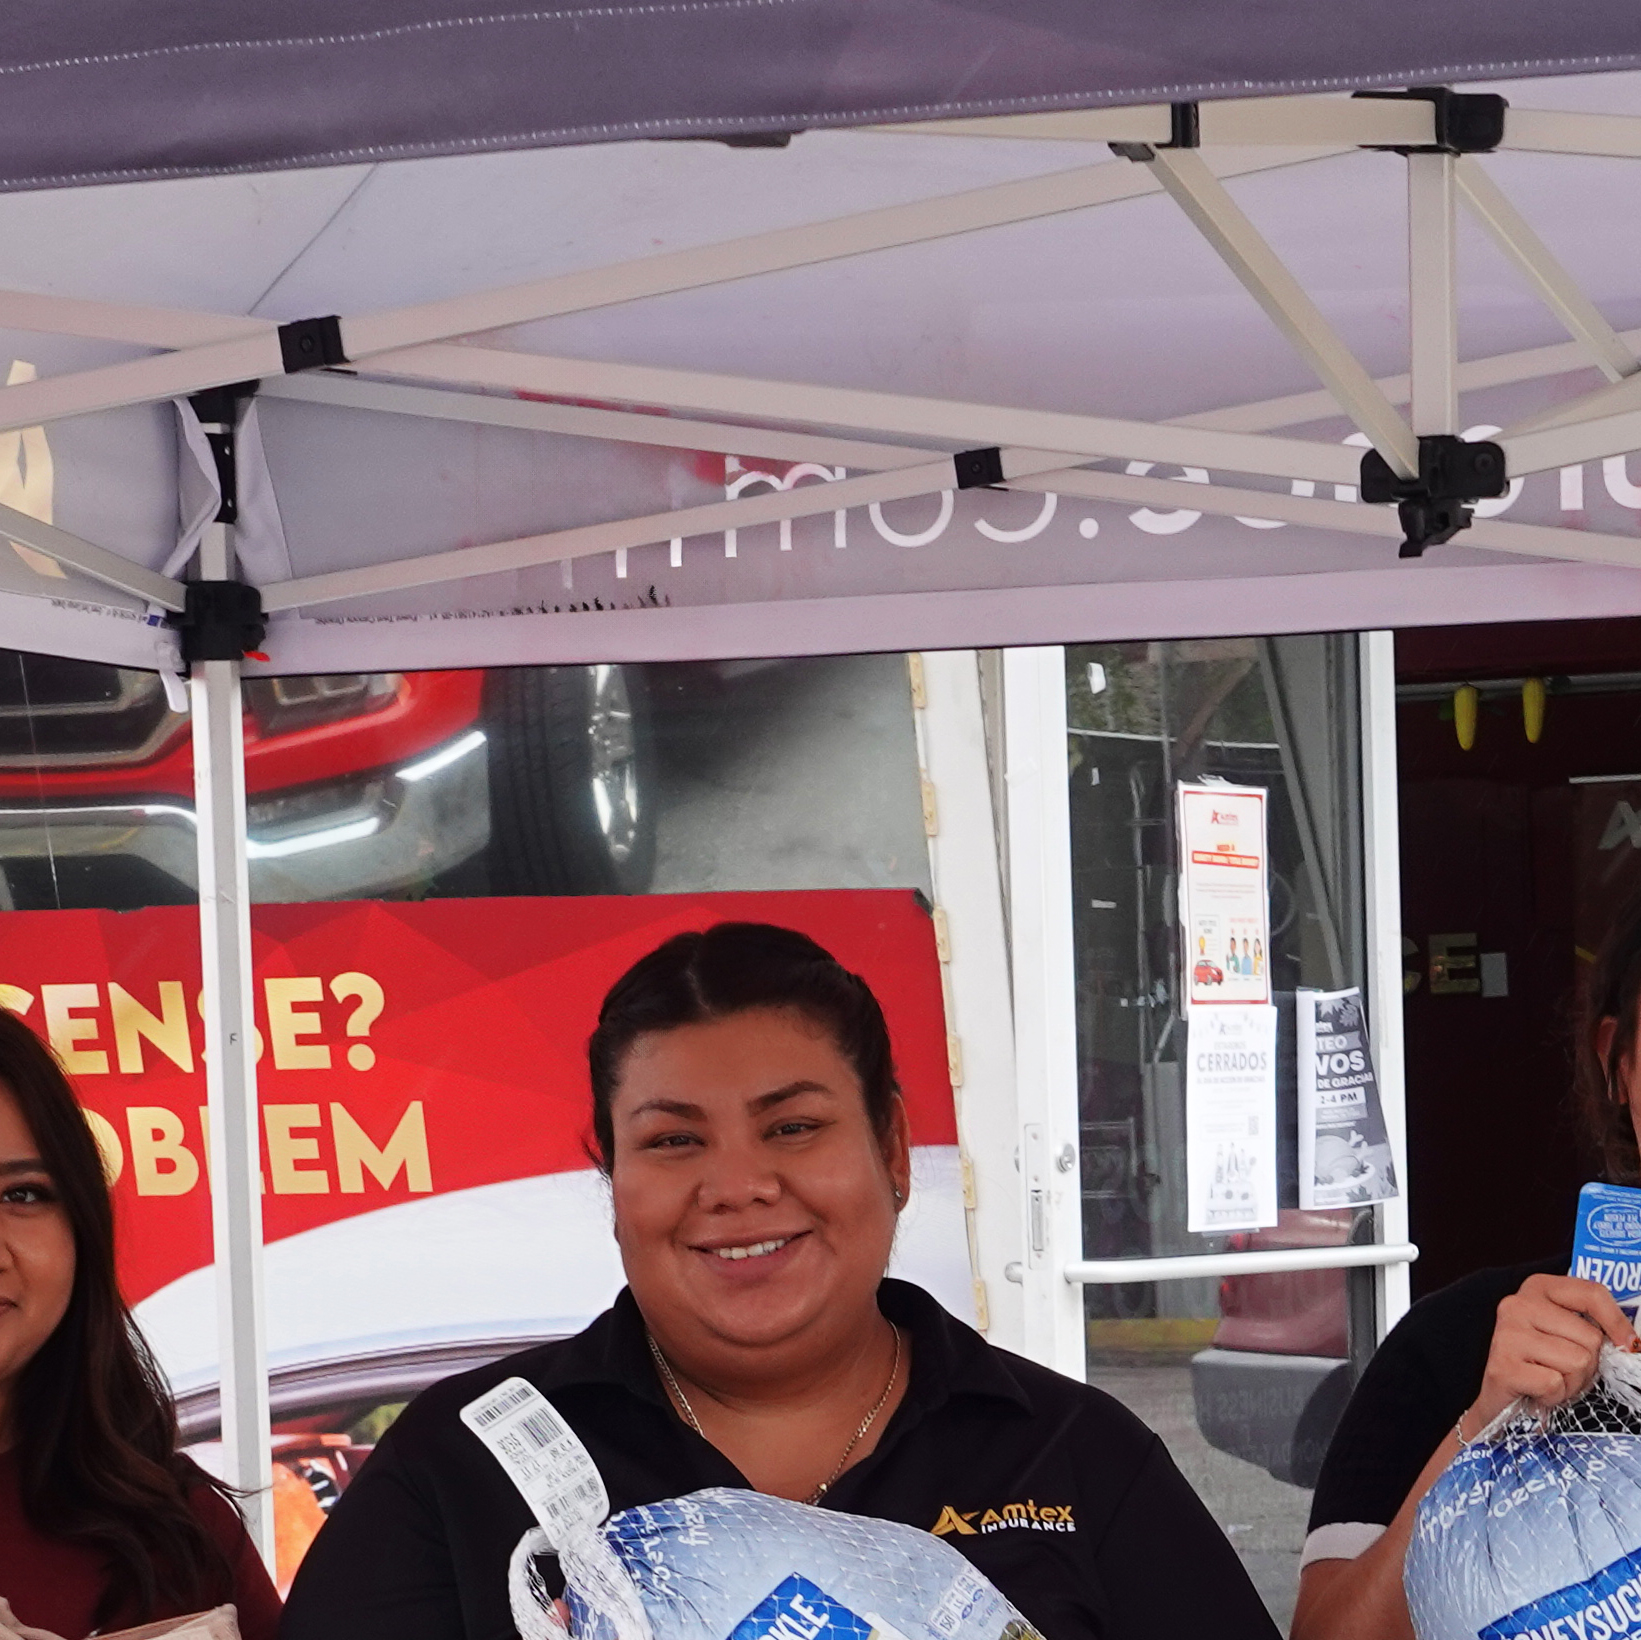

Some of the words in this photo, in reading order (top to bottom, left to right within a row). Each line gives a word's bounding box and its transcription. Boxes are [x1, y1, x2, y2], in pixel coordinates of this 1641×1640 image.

[1196, 1052, 1268, 1073] CERRADOS
[979, 1499, 1075, 1525] Amtex
[980, 1518, 1078, 1534] INSURANCE
